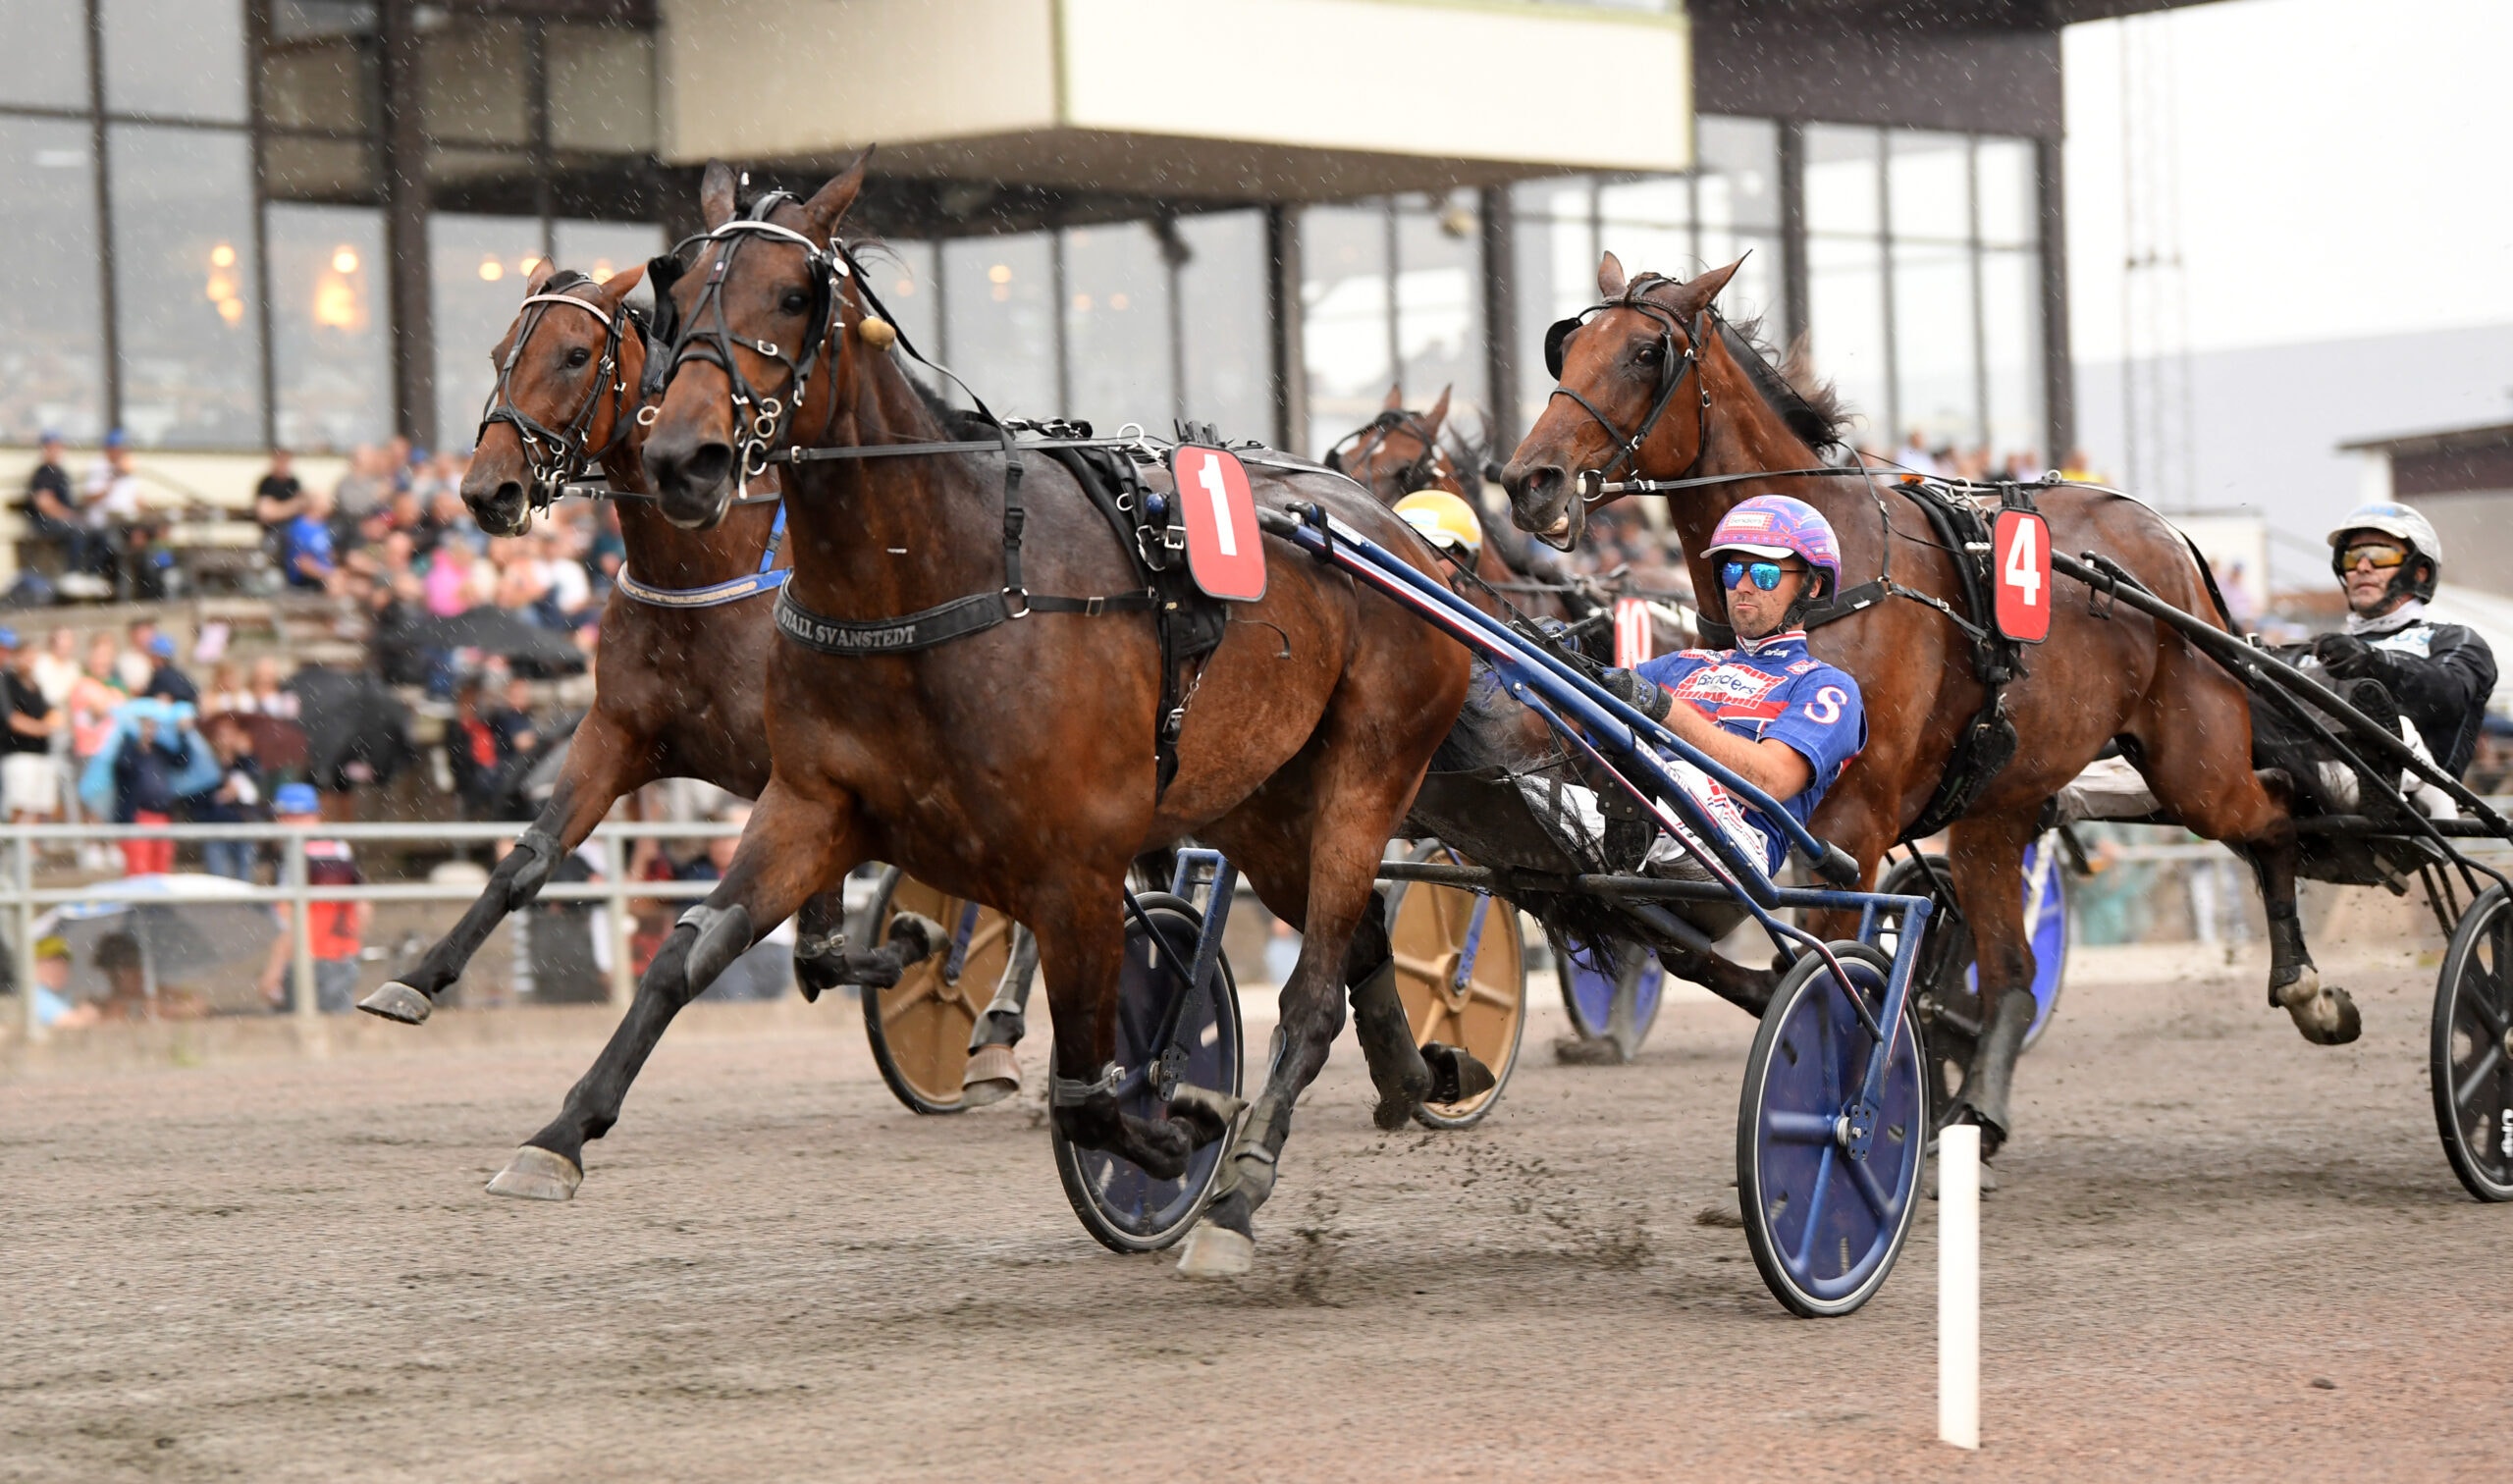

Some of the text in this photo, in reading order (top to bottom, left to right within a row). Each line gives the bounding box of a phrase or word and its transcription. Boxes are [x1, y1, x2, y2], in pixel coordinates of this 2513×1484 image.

[1198, 453, 1238, 556] 1
[2005, 517, 2041, 607] 4
[780, 606, 916, 648] STALL SVANSTEDT
[1616, 600, 1652, 670] 10
[1803, 685, 1848, 724] S
